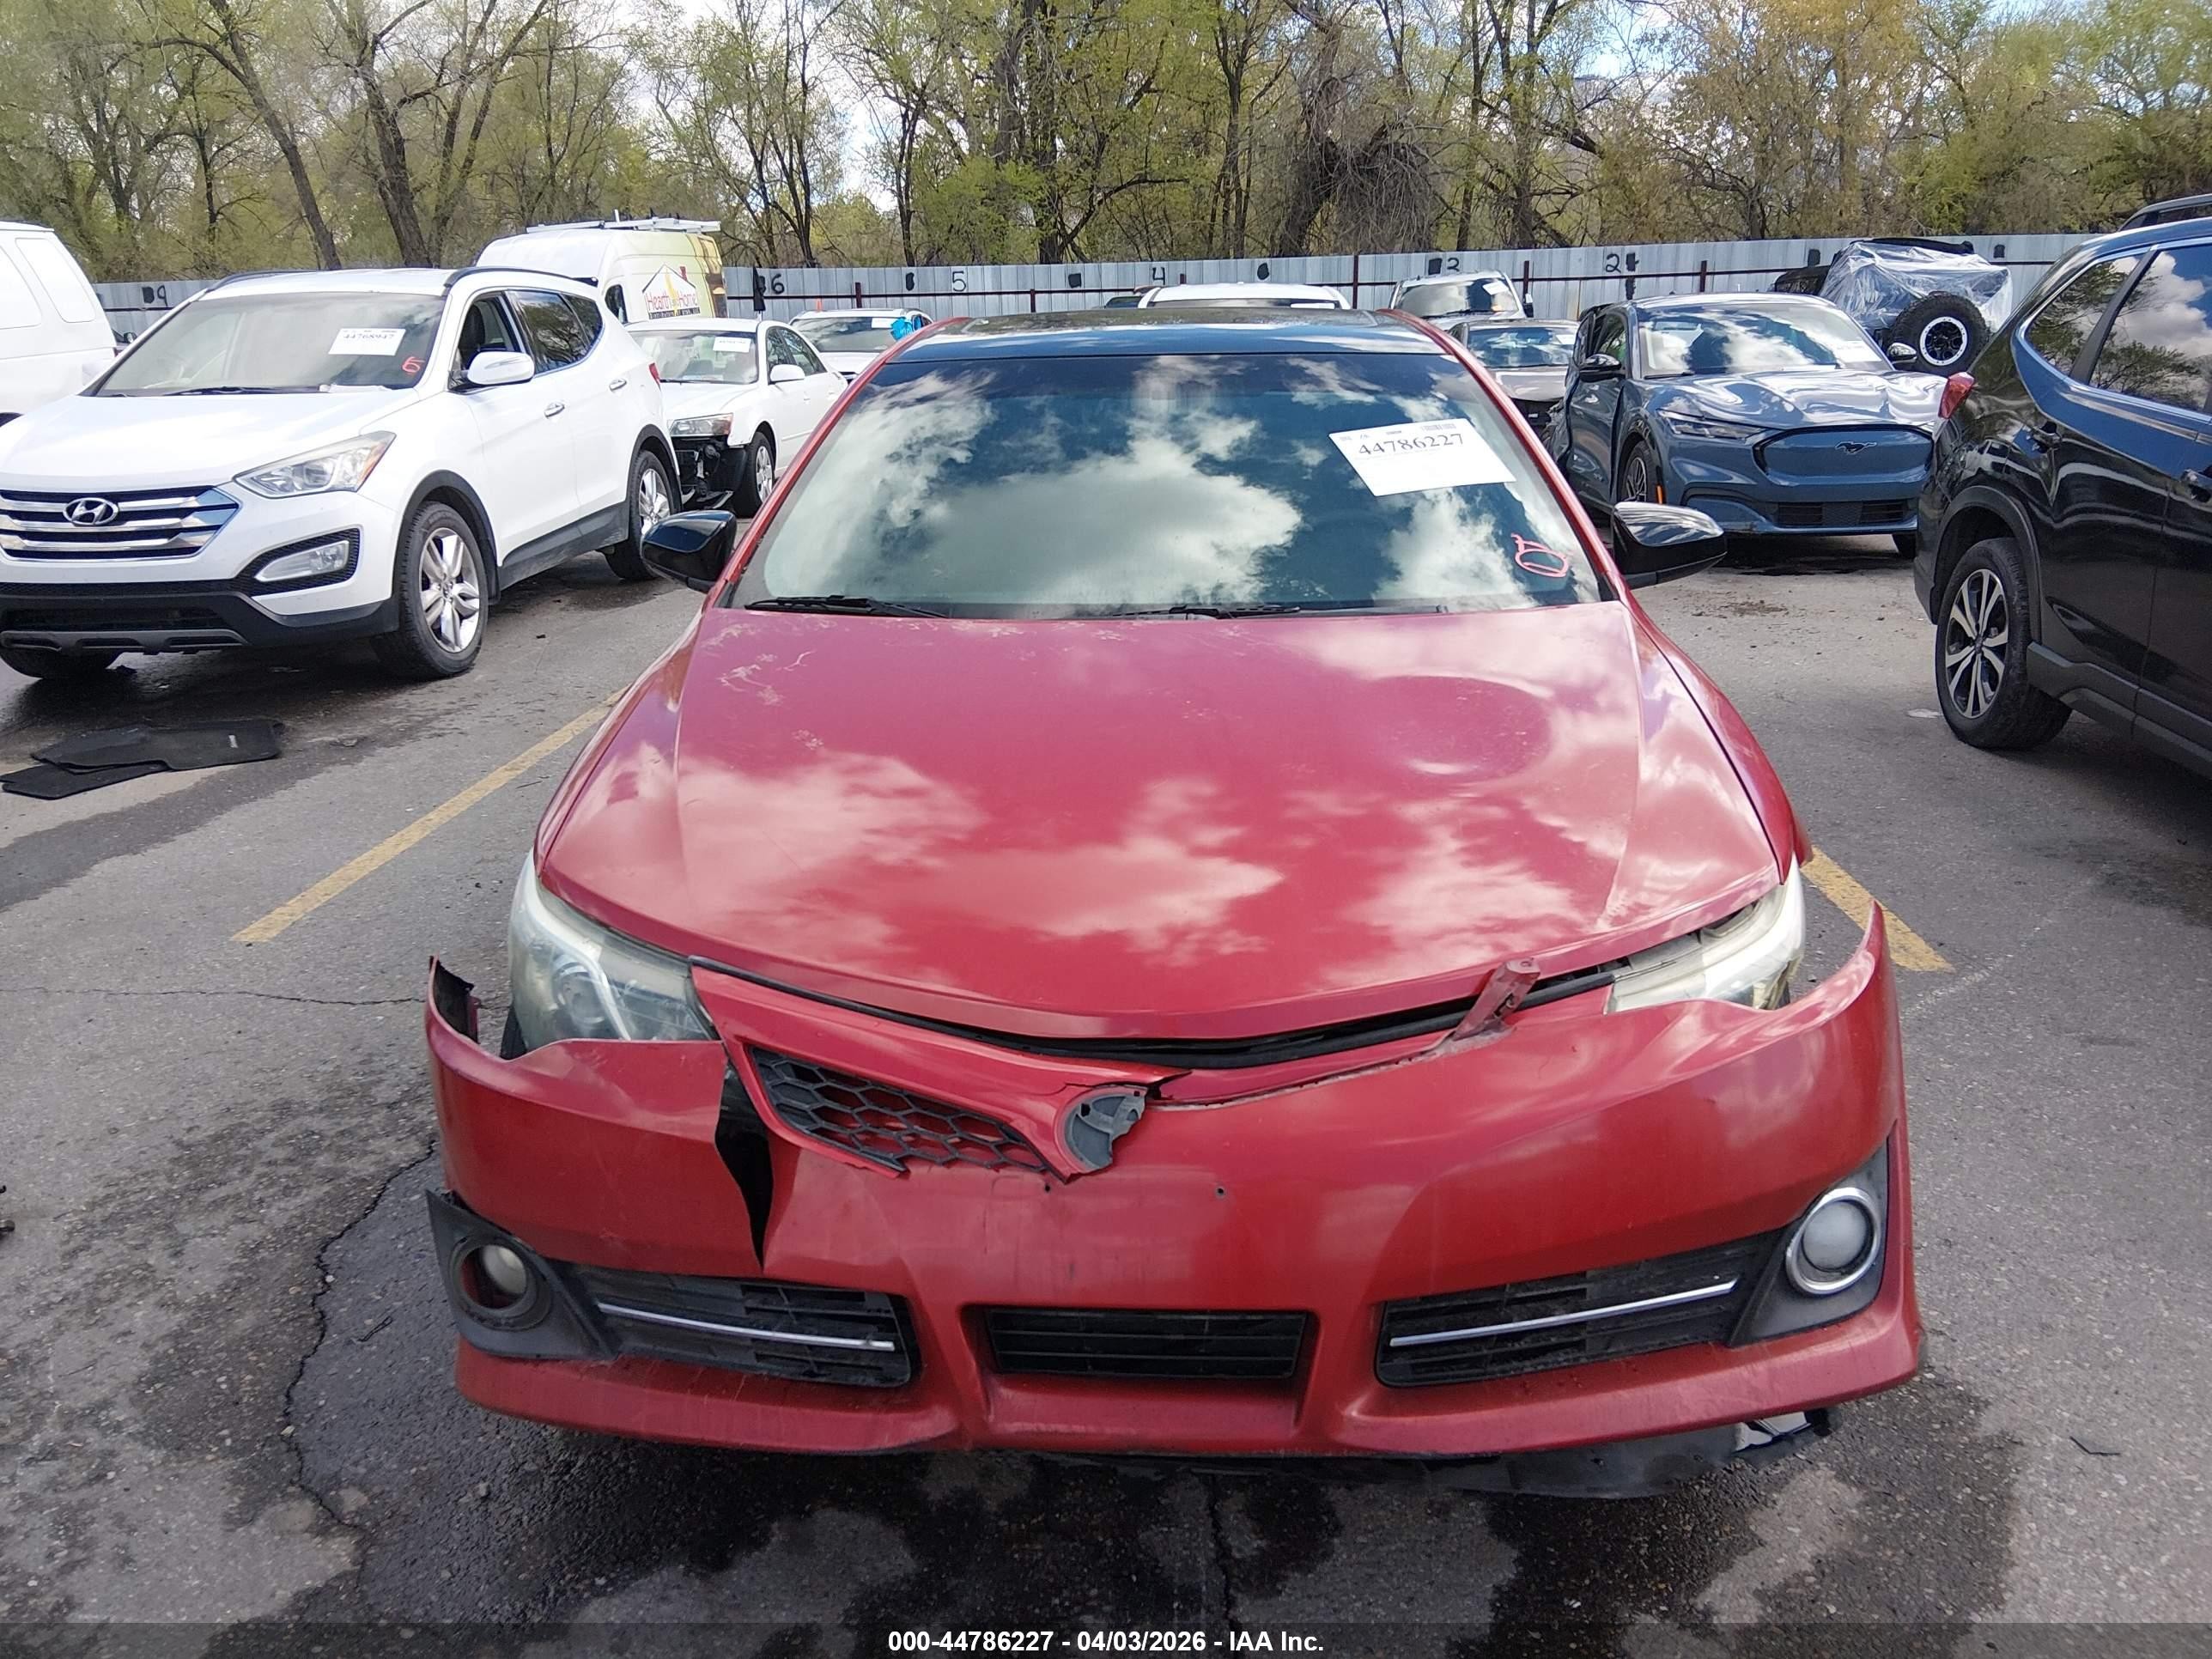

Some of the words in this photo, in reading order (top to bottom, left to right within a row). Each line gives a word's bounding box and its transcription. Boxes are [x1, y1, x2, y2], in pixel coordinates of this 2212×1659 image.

[1605, 252, 1622, 274] 2
[771, 273, 785, 295] 6
[951, 270, 967, 292] 5
[1152, 266, 1166, 286] 4
[1358, 432, 1464, 456] 44786227
